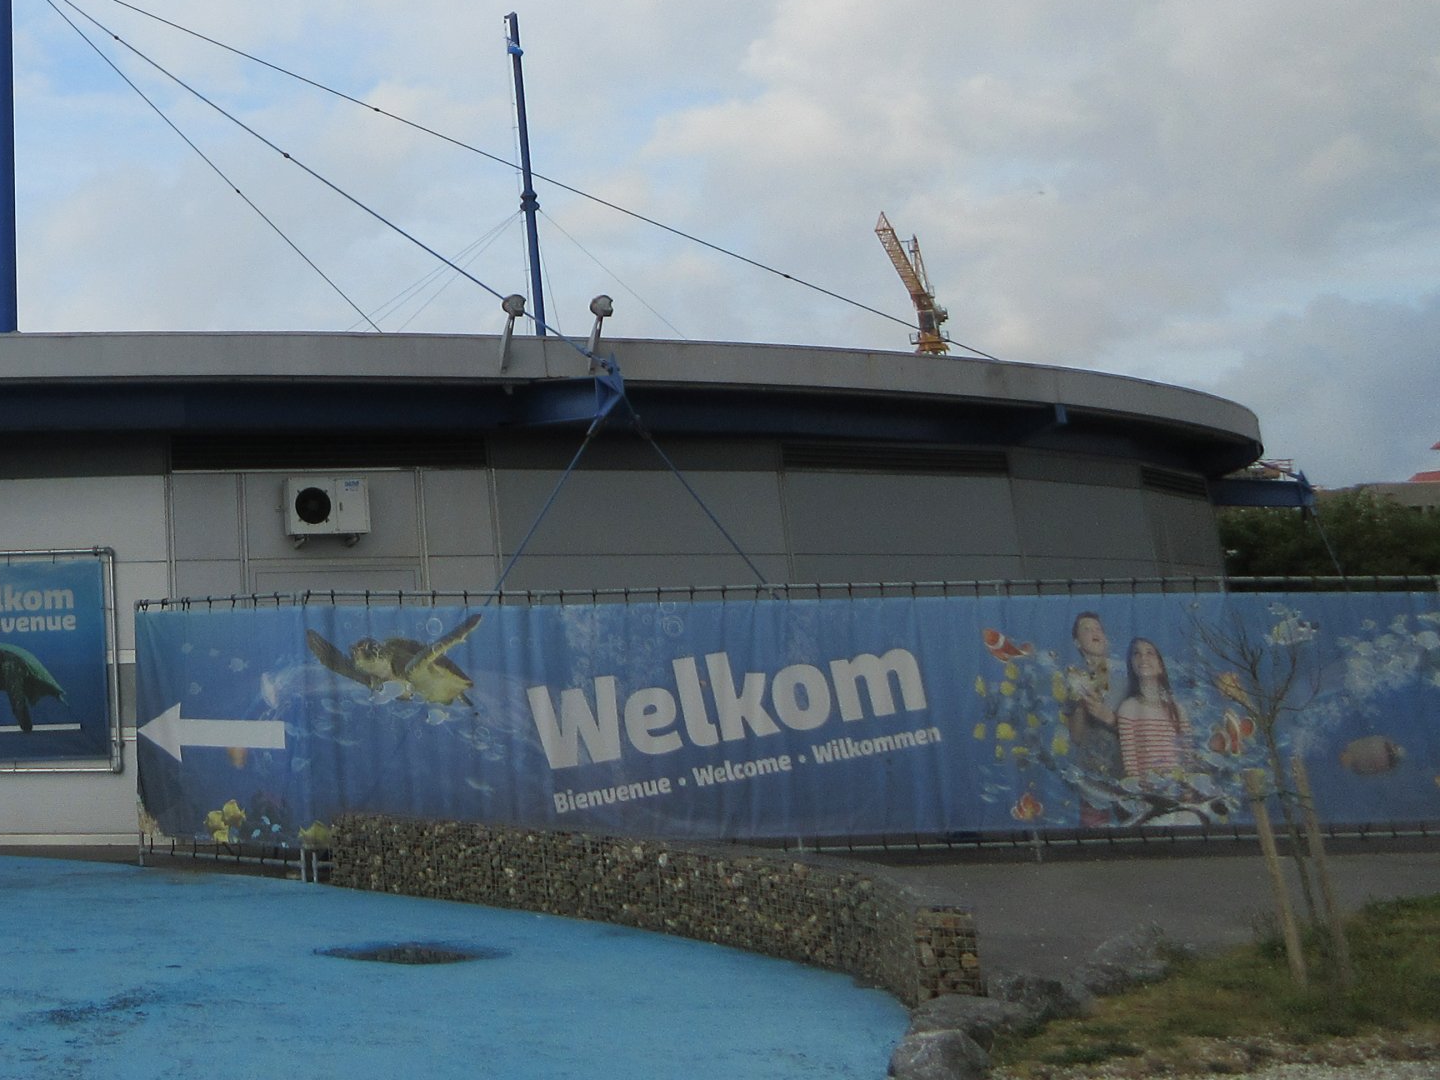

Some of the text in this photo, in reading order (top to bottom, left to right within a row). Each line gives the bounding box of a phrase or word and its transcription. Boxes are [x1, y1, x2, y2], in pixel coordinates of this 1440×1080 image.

[526, 648, 927, 770] Welkom
[553, 726, 942, 814] Bienvenue Welcome Wilkommen
